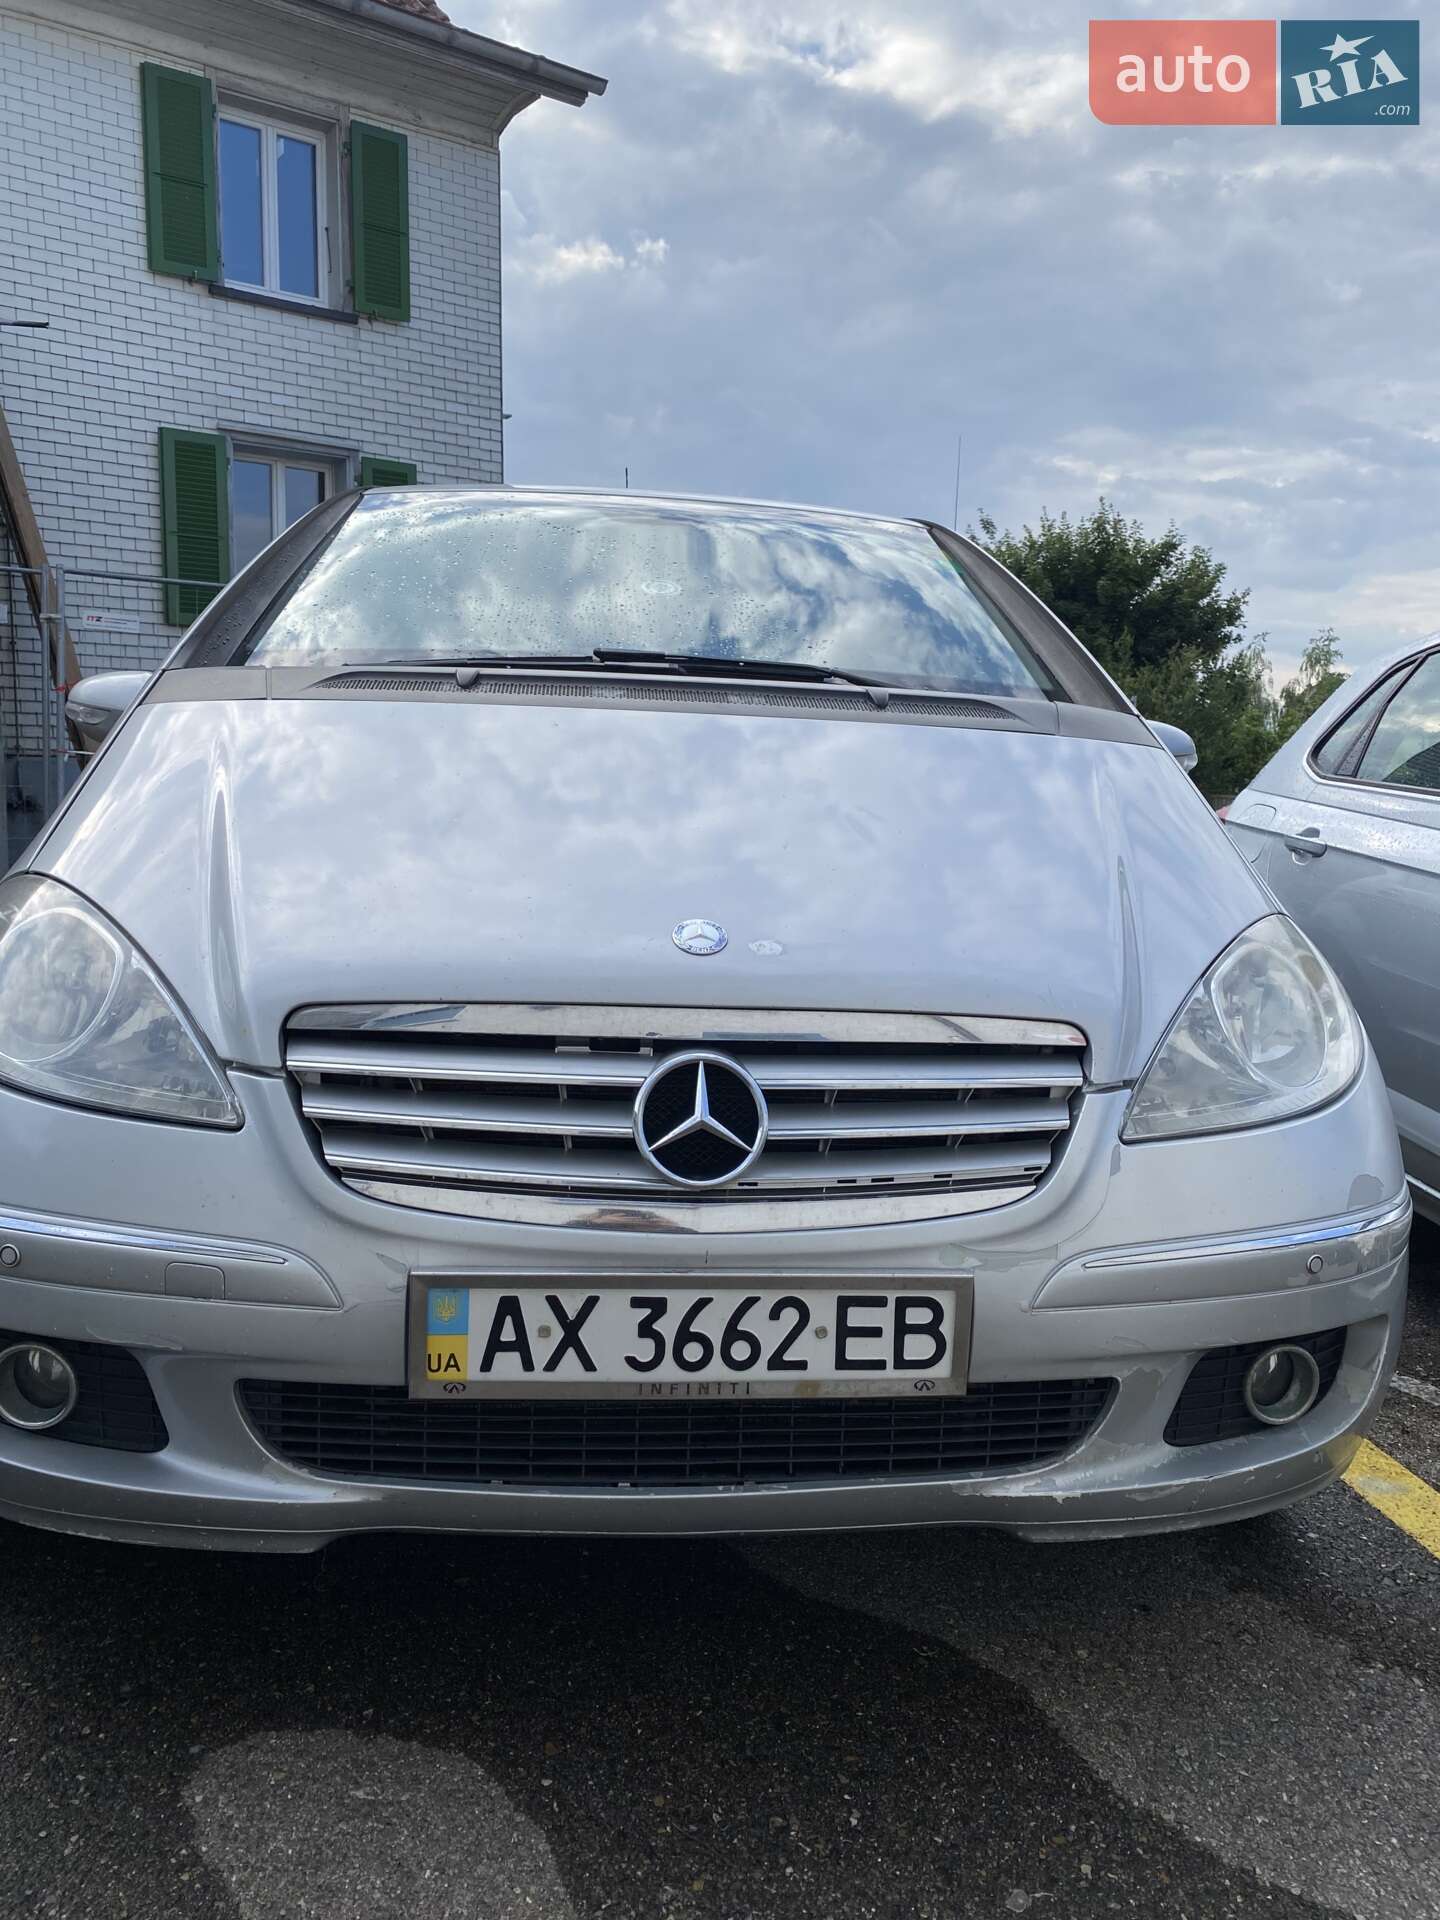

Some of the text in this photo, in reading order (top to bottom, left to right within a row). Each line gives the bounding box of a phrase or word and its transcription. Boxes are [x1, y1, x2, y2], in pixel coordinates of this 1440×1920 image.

[479, 1295, 947, 1373] AX 3662 EB
[427, 1352, 461, 1373] UA
[638, 1381, 751, 1396] INFINITI
